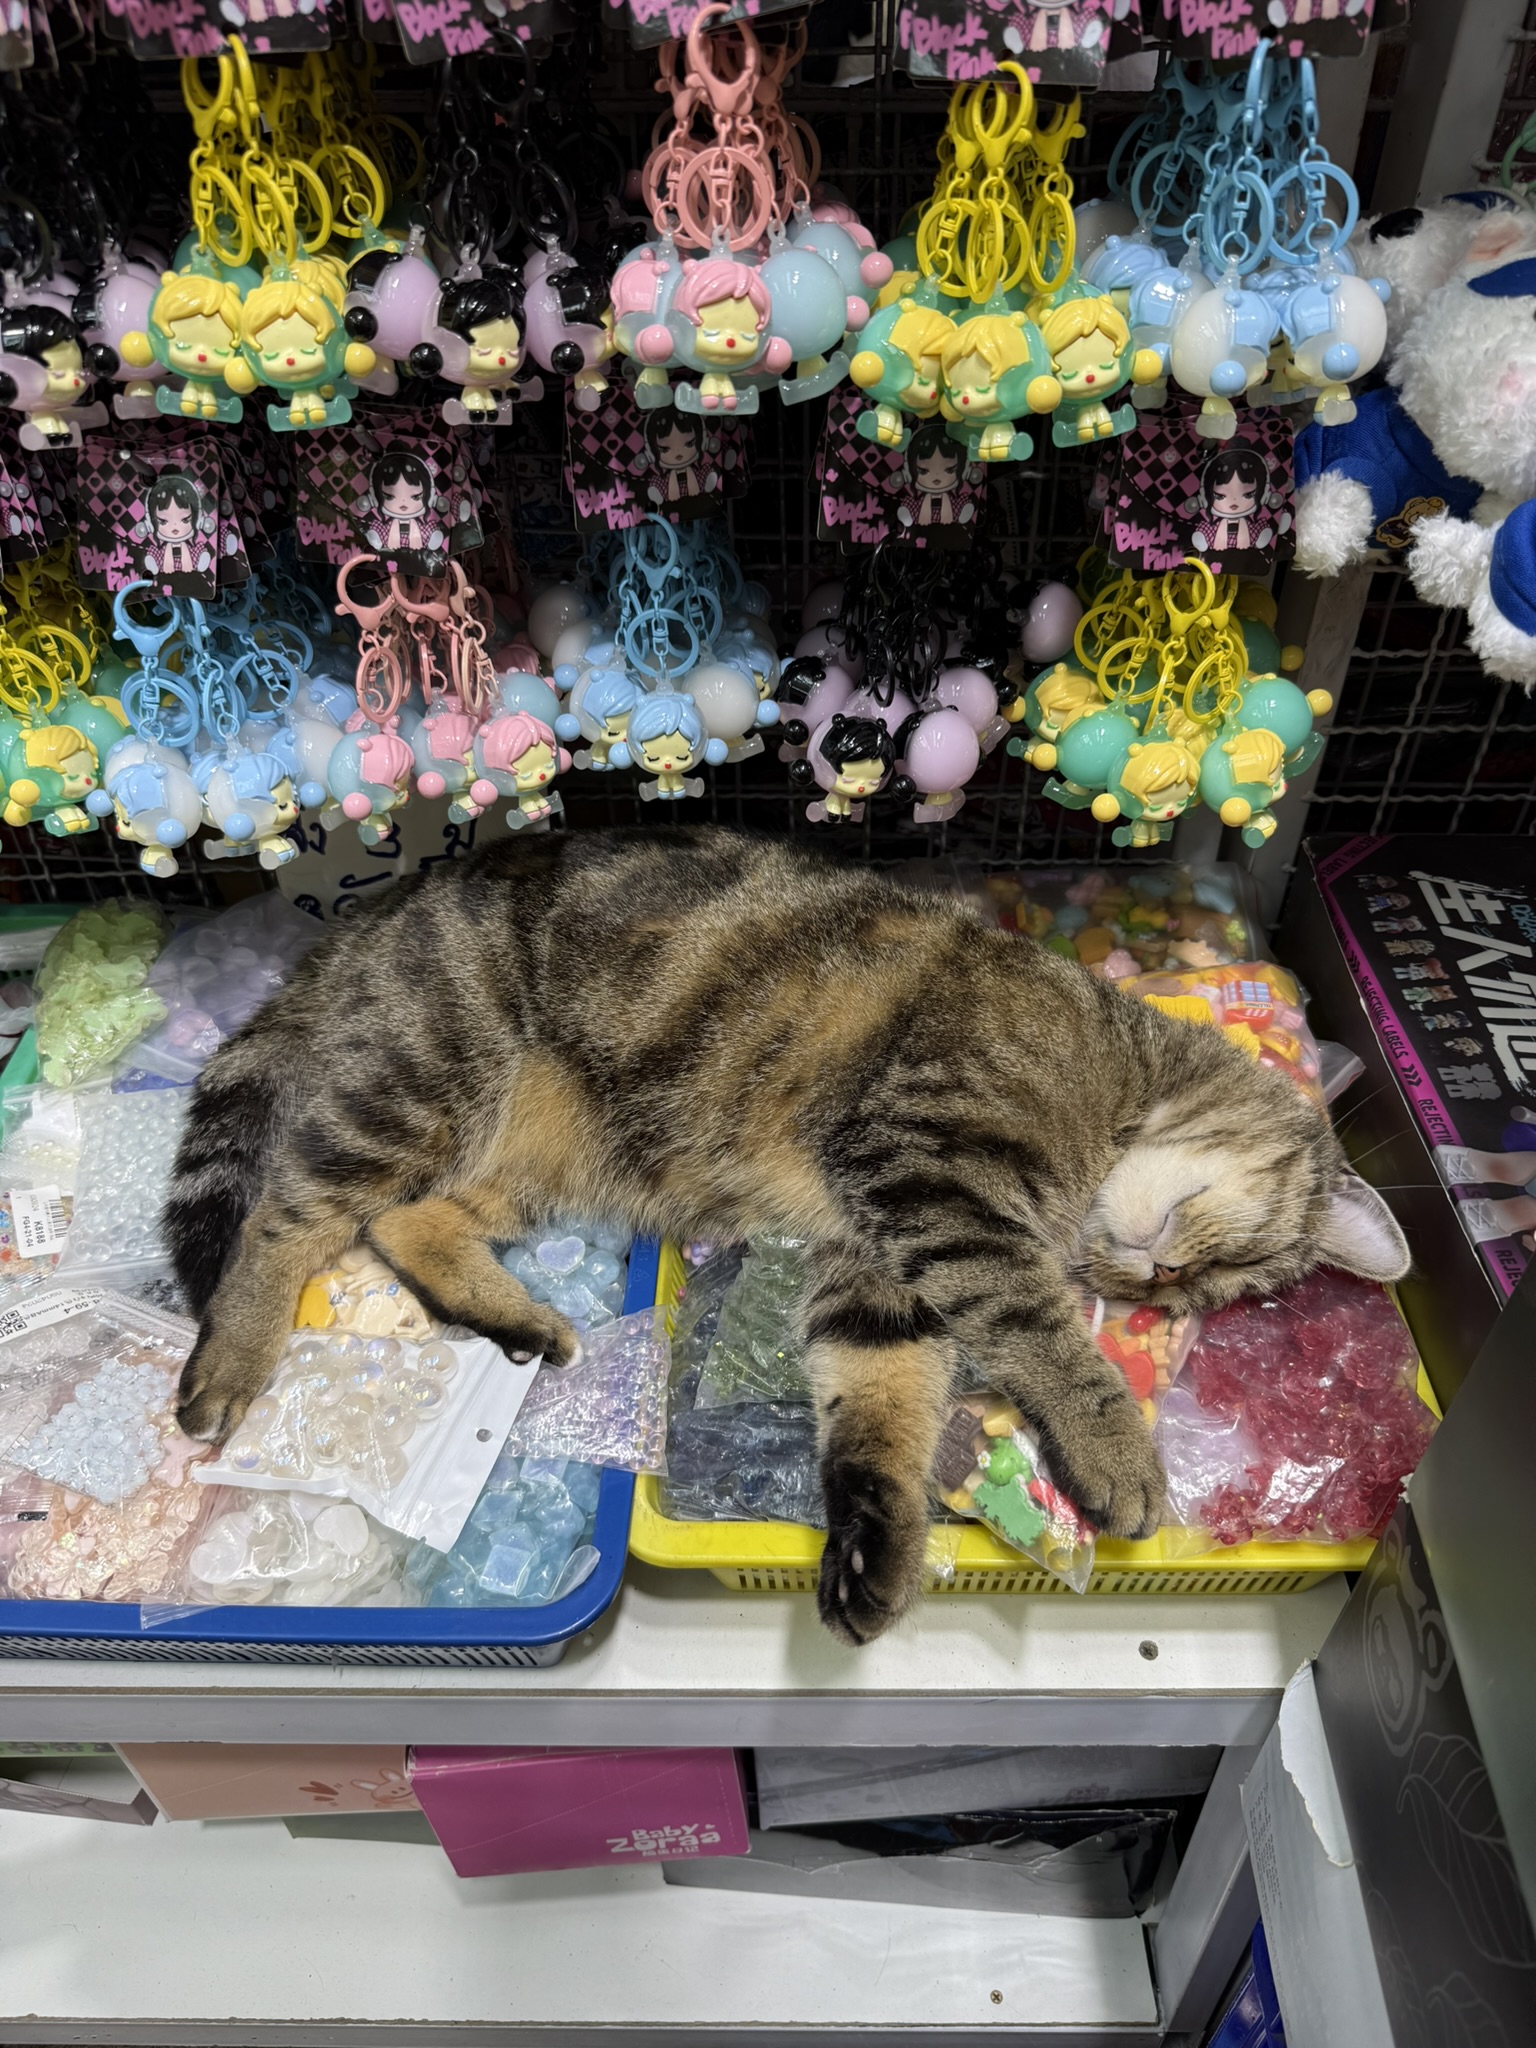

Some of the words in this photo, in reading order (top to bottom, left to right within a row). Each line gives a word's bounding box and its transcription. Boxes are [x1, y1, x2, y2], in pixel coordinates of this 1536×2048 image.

[912, 9, 989, 58] Black
[1211, 22, 1258, 59] Pink
[947, 46, 998, 80] Pink
[574, 478, 636, 519] Black
[822, 492, 885, 527] Black
[297, 515, 355, 546] Black
[605, 503, 648, 530] Pink
[850, 520, 890, 543] Pink
[1113, 517, 1179, 553] Black
[78, 541, 134, 575] Black
[1142, 546, 1186, 571] Pink
[1360, 975, 1391, 1026] REJECTING
[1382, 1024, 1409, 1060] LABELS
[1417, 1098, 1457, 1146] REJECTIN
[1494, 1248, 1525, 1288] REJEC
[606, 1831, 721, 1853] Zoraa
[631, 1823, 700, 1841] Baby
